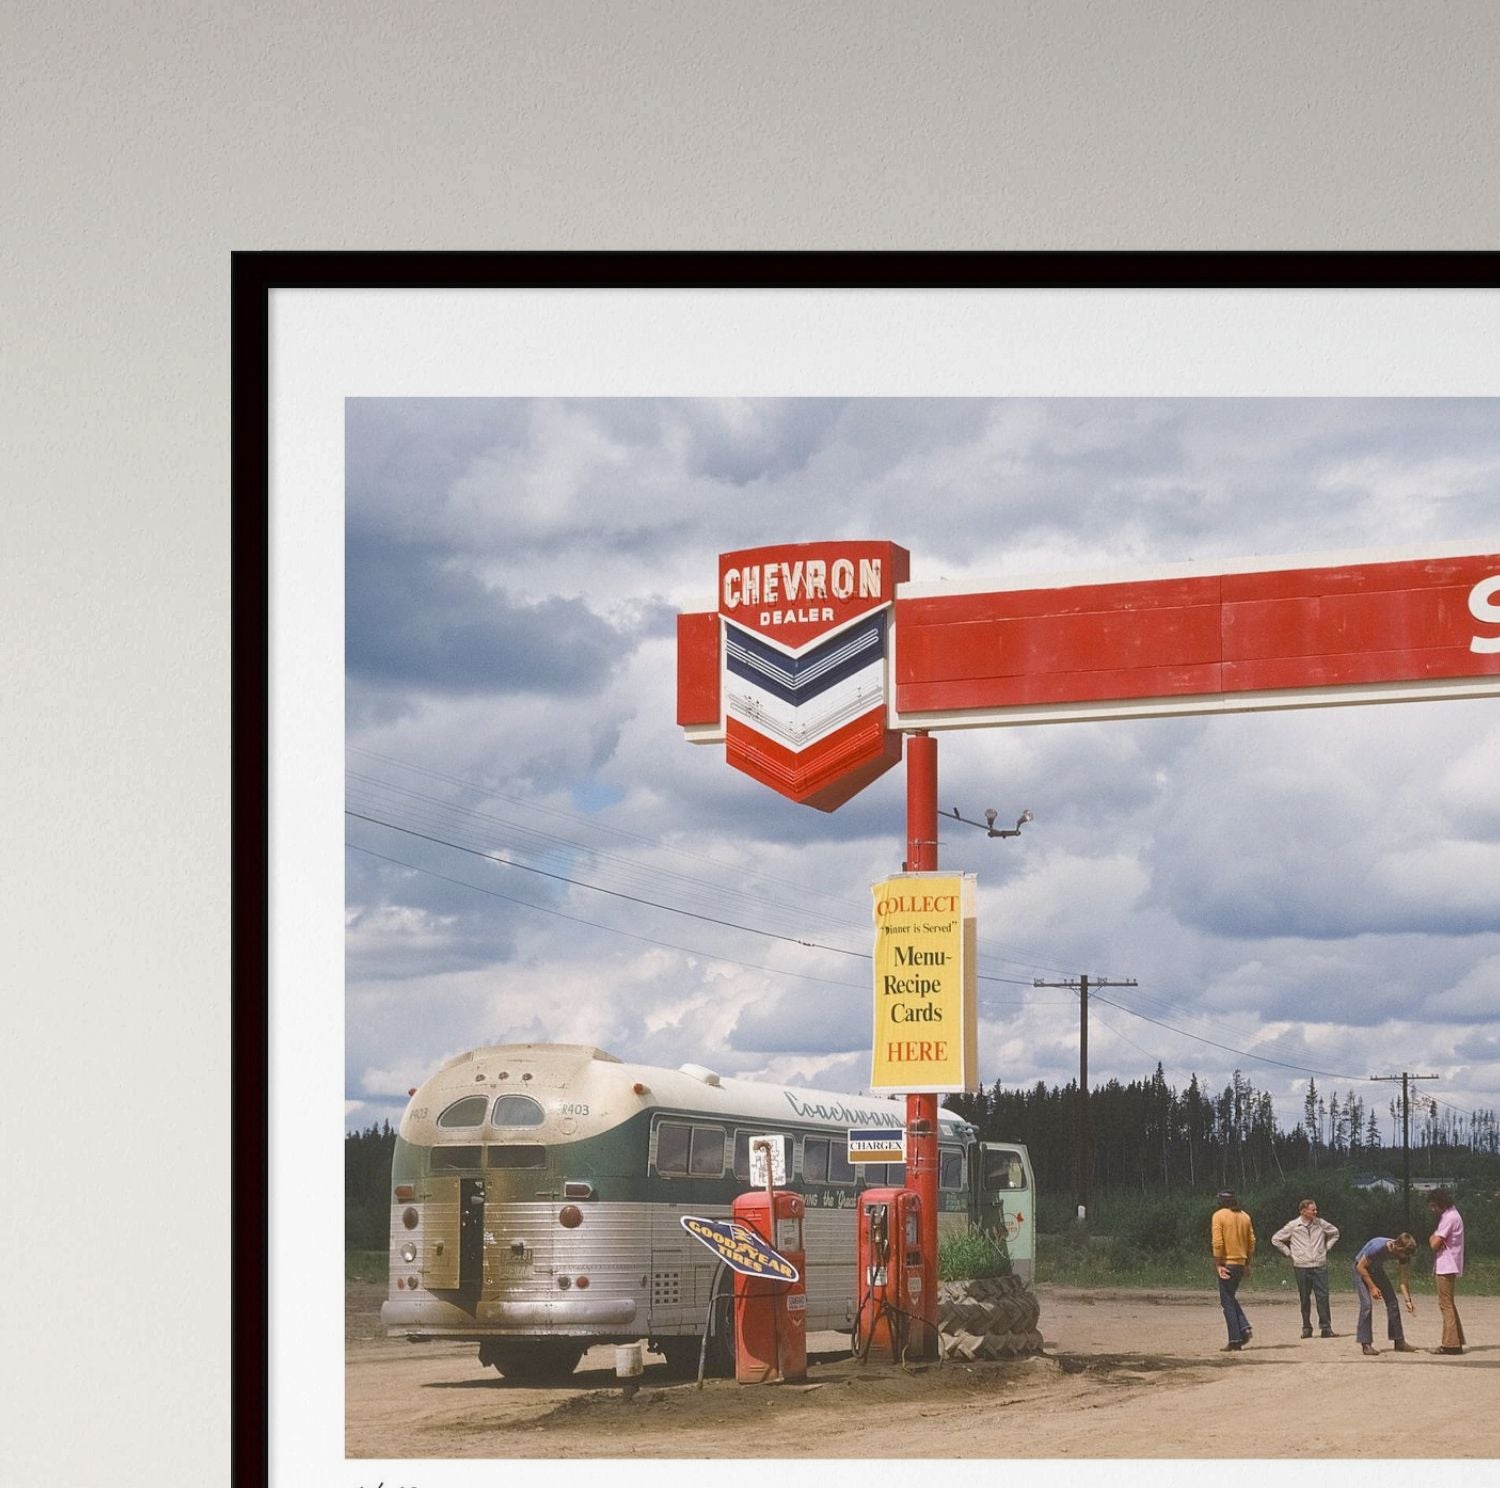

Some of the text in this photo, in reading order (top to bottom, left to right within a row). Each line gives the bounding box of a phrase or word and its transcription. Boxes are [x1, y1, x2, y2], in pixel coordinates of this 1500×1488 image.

[723, 557, 883, 609] CHEVRON
[759, 608, 835, 626] DEALER
[877, 896, 959, 916] COLLECT
[913, 923, 921, 933] is
[894, 946, 953, 967] Menu-
[883, 974, 942, 998] Recipe
[890, 1003, 943, 1023] Cards
[887, 1041, 948, 1062] HERE
[849, 1141, 902, 1150] CHARGEX
[688, 1220, 793, 1279] GOODYEAR
[717, 1243, 763, 1273] TIRES
